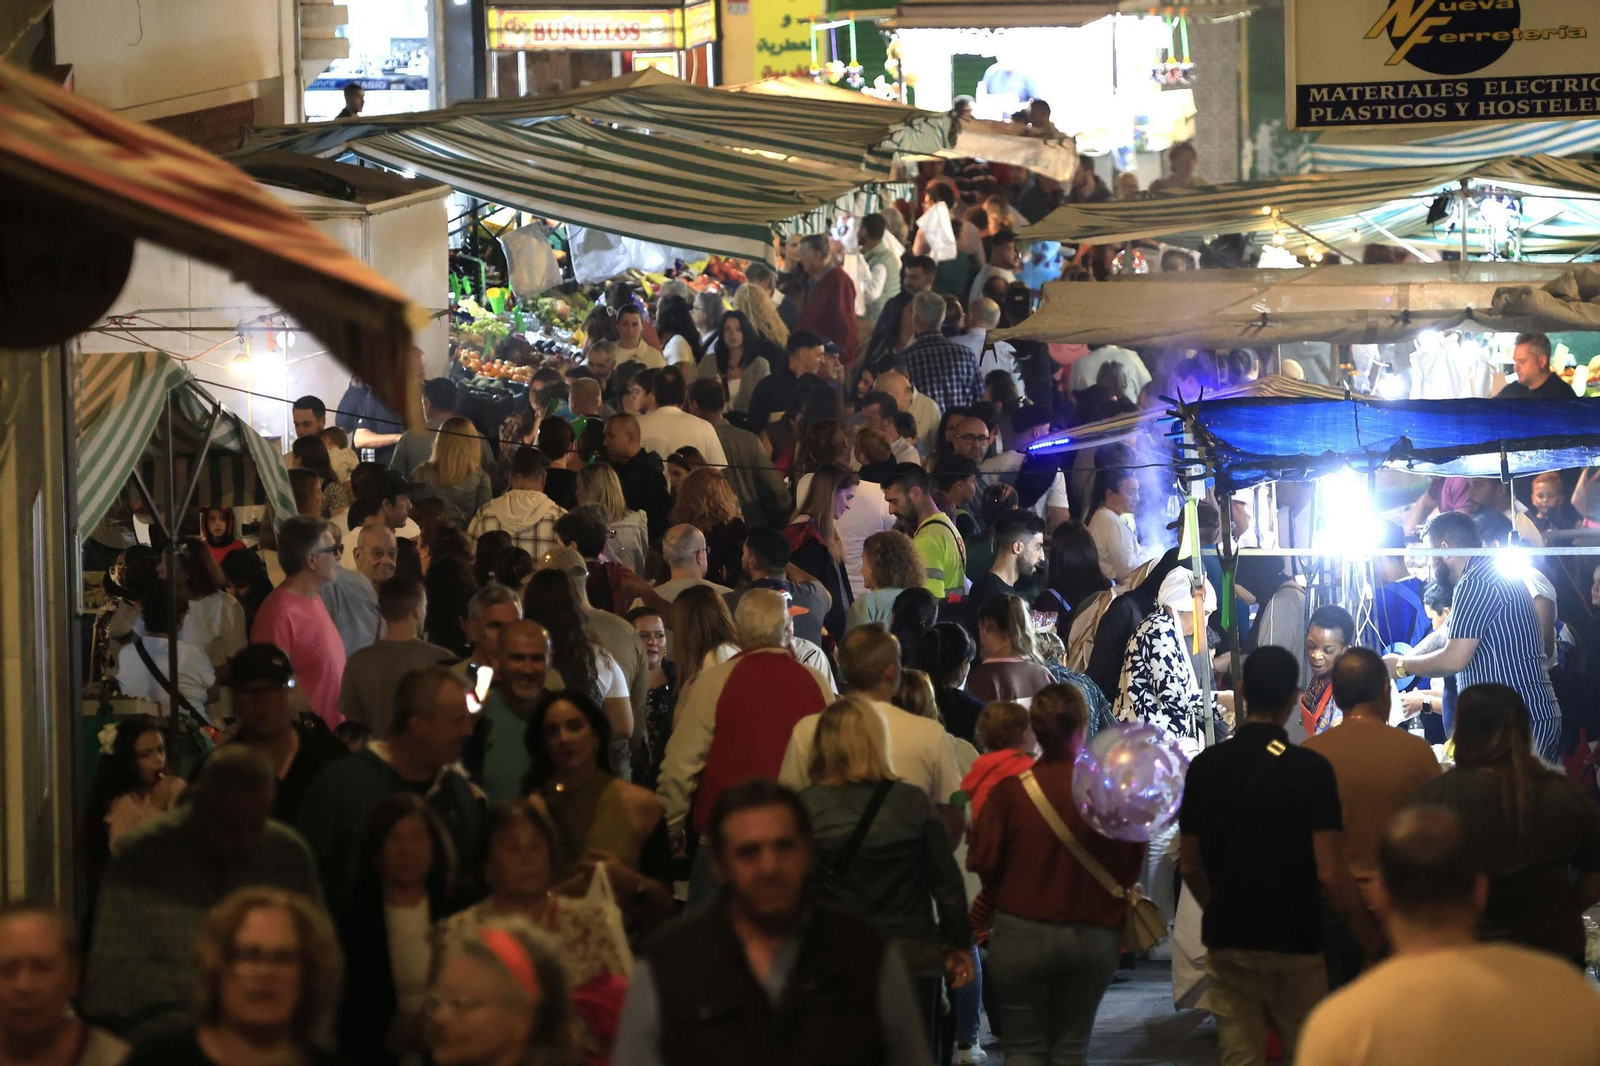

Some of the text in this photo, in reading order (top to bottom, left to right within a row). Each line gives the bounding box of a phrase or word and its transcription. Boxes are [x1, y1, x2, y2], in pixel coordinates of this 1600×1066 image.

[1363, 0, 1514, 39] Nueva
[1384, 16, 1588, 66] Ferretería
[356, 80, 387, 90] ASIO
[1308, 82, 1469, 102] MATERIALES
[1309, 102, 1448, 122] PLASTICOS
[1454, 102, 1470, 116] Y
